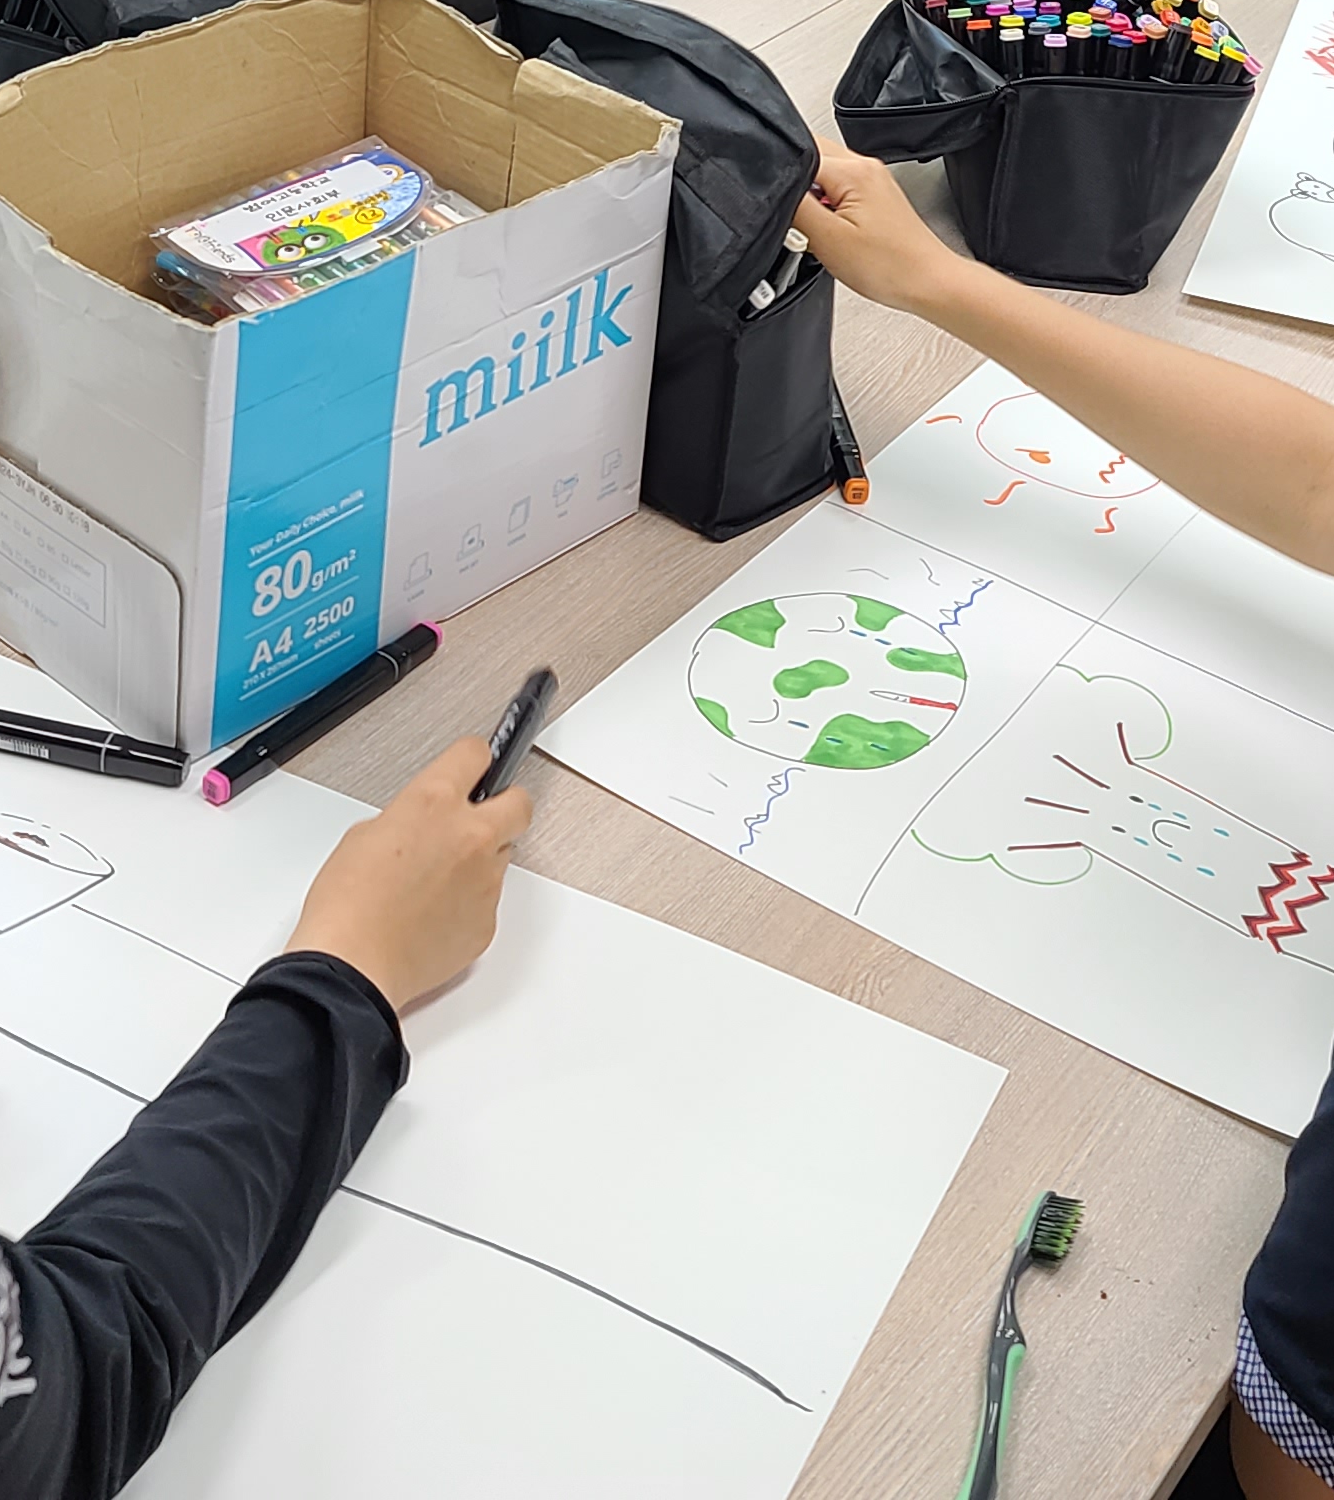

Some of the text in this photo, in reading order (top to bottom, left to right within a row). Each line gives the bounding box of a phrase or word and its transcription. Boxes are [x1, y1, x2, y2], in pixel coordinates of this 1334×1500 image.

[418, 268, 634, 448] miilk
[249, 536, 274, 556] Your
[275, 523, 302, 544] Daily
[249, 596, 355, 673] A4 2500
